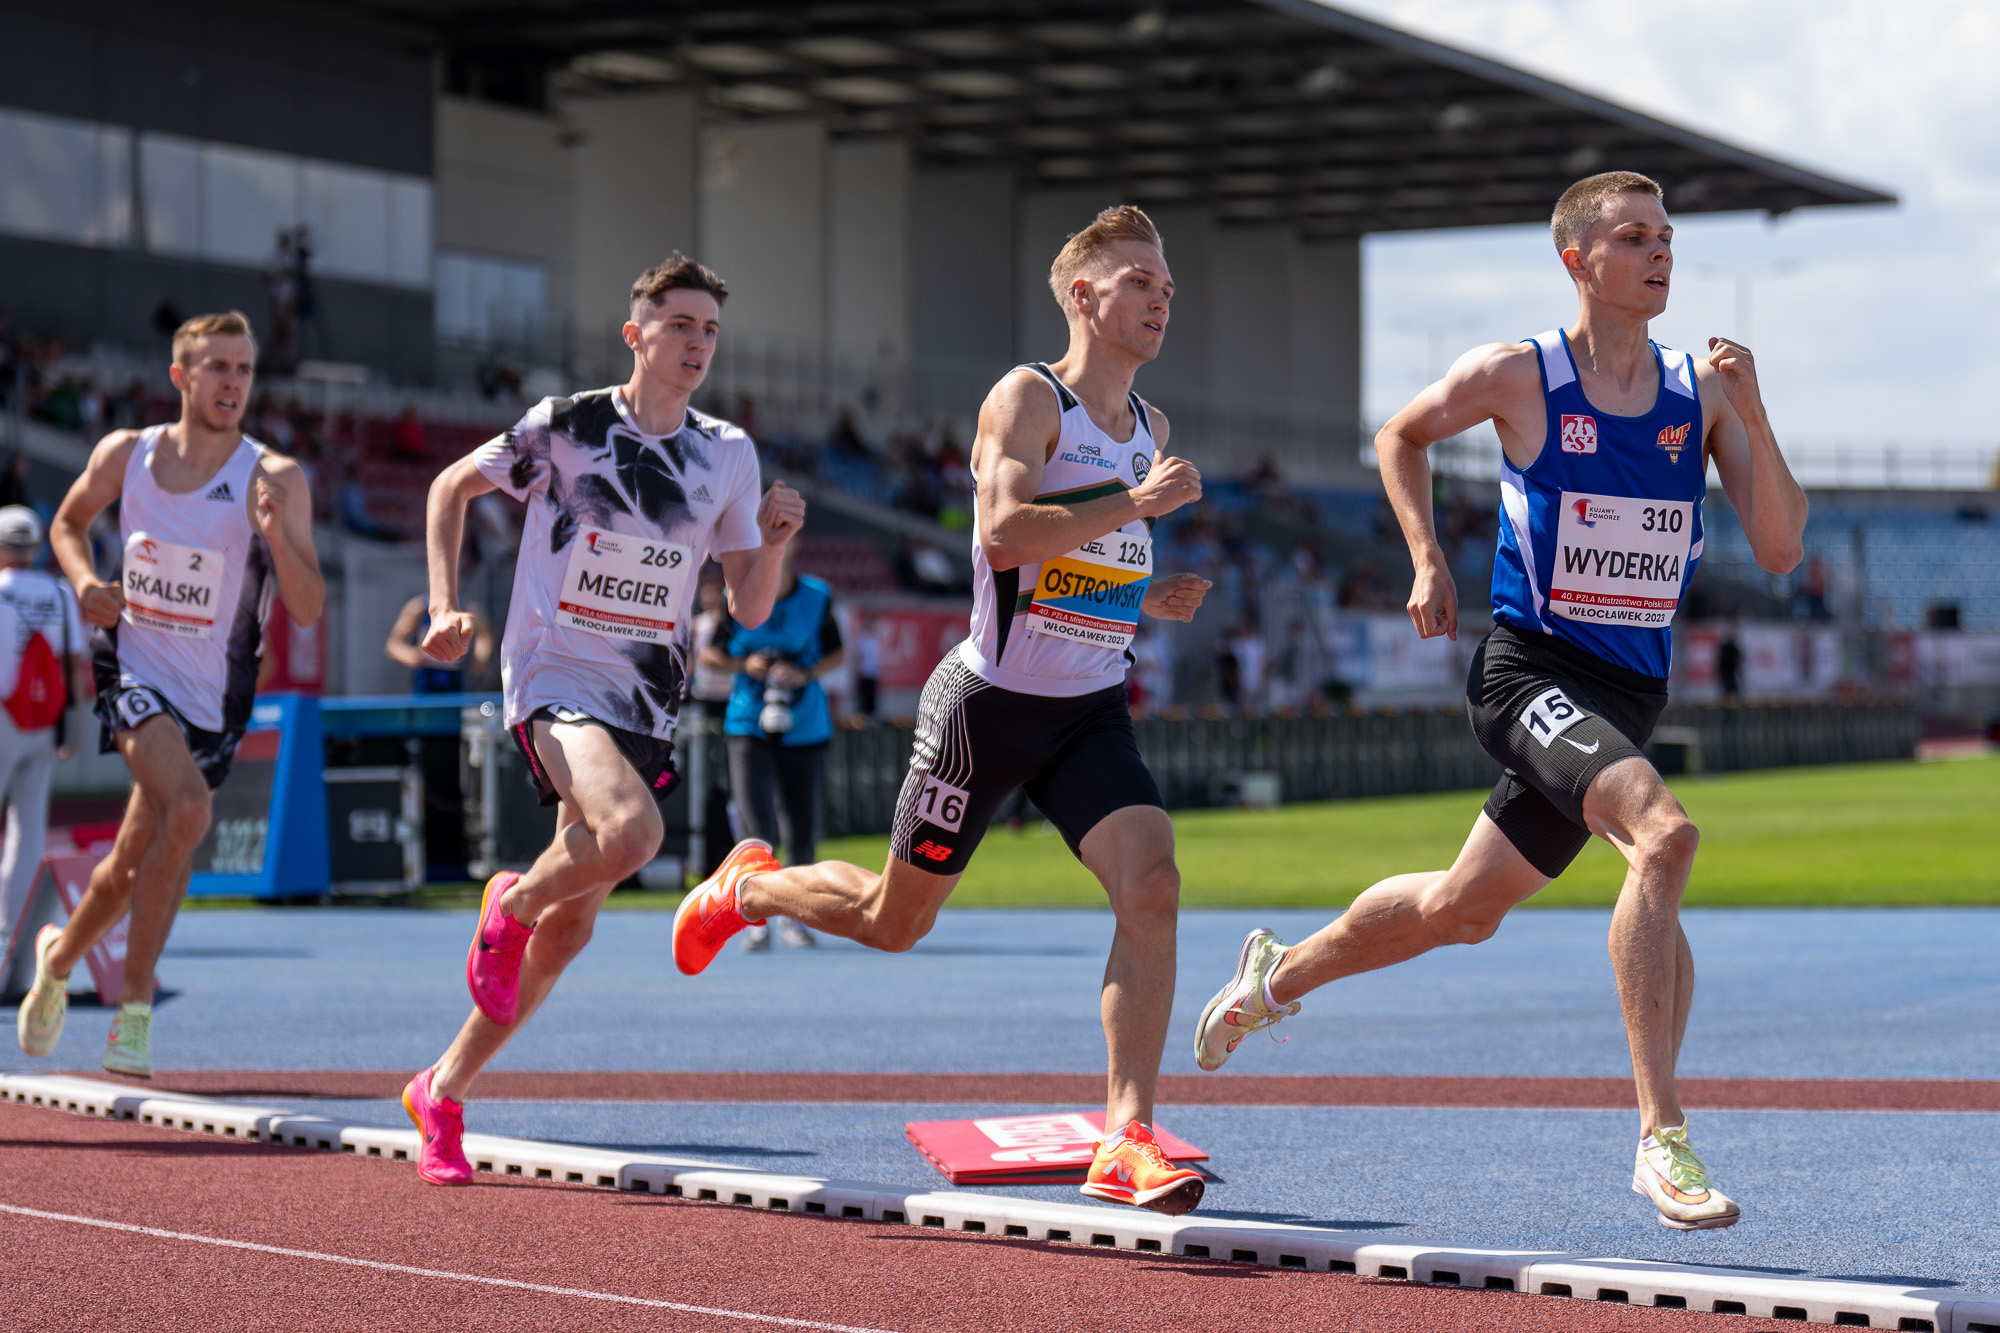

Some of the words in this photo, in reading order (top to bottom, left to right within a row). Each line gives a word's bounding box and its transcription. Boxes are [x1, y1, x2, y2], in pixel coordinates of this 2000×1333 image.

[1656, 422, 1691, 445] AWF
[1060, 452, 1116, 471] IGLOTECH
[1078, 443, 1101, 457] esa
[1588, 512, 1620, 521] POMORZE
[1589, 506, 1616, 514] KUJAWY
[1641, 507, 1683, 533] 310
[640, 545, 682, 569] 269
[1080, 541, 1106, 556] UEL
[1117, 541, 1146, 566] 126
[188, 553, 202, 571] 2
[1563, 545, 1679, 582] WYDERKA
[127, 570, 211, 607] SKALSKI
[577, 569, 669, 608] MEGIER
[1044, 568, 1145, 609] OSTROWSKI
[1561, 592, 1574, 601] 40.
[1576, 593, 1596, 603] PZLA
[1597, 596, 1642, 607] Mistrzostwa
[1644, 600, 1663, 608] Polski
[1663, 600, 1673, 608] U23
[578, 607, 595, 617] PZLA
[595, 612, 635, 624] Mistrzostwa
[635, 618, 655, 627] Polski
[655, 621, 668, 629] U23
[1038, 607, 1050, 617] 40.
[1051, 610, 1068, 621] PZLA
[1069, 615, 1108, 630] Mistrzostwa
[1108, 623, 1122, 632] Polski
[1122, 625, 1132, 633] U23
[1568, 606, 1643, 622] WŁOCŁAWEK
[1644, 612, 1666, 623] 2023
[571, 616, 633, 636] WŁOCŁAWEK
[635, 628, 658, 639] 2023
[1043, 621, 1106, 643] WŁOCŁAWEK
[1107, 634, 1125, 645] 2023
[127, 692, 151, 716] 6
[1528, 693, 1575, 735] 15
[924, 785, 964, 824] 16
[1103, 1158, 1134, 1183] N
